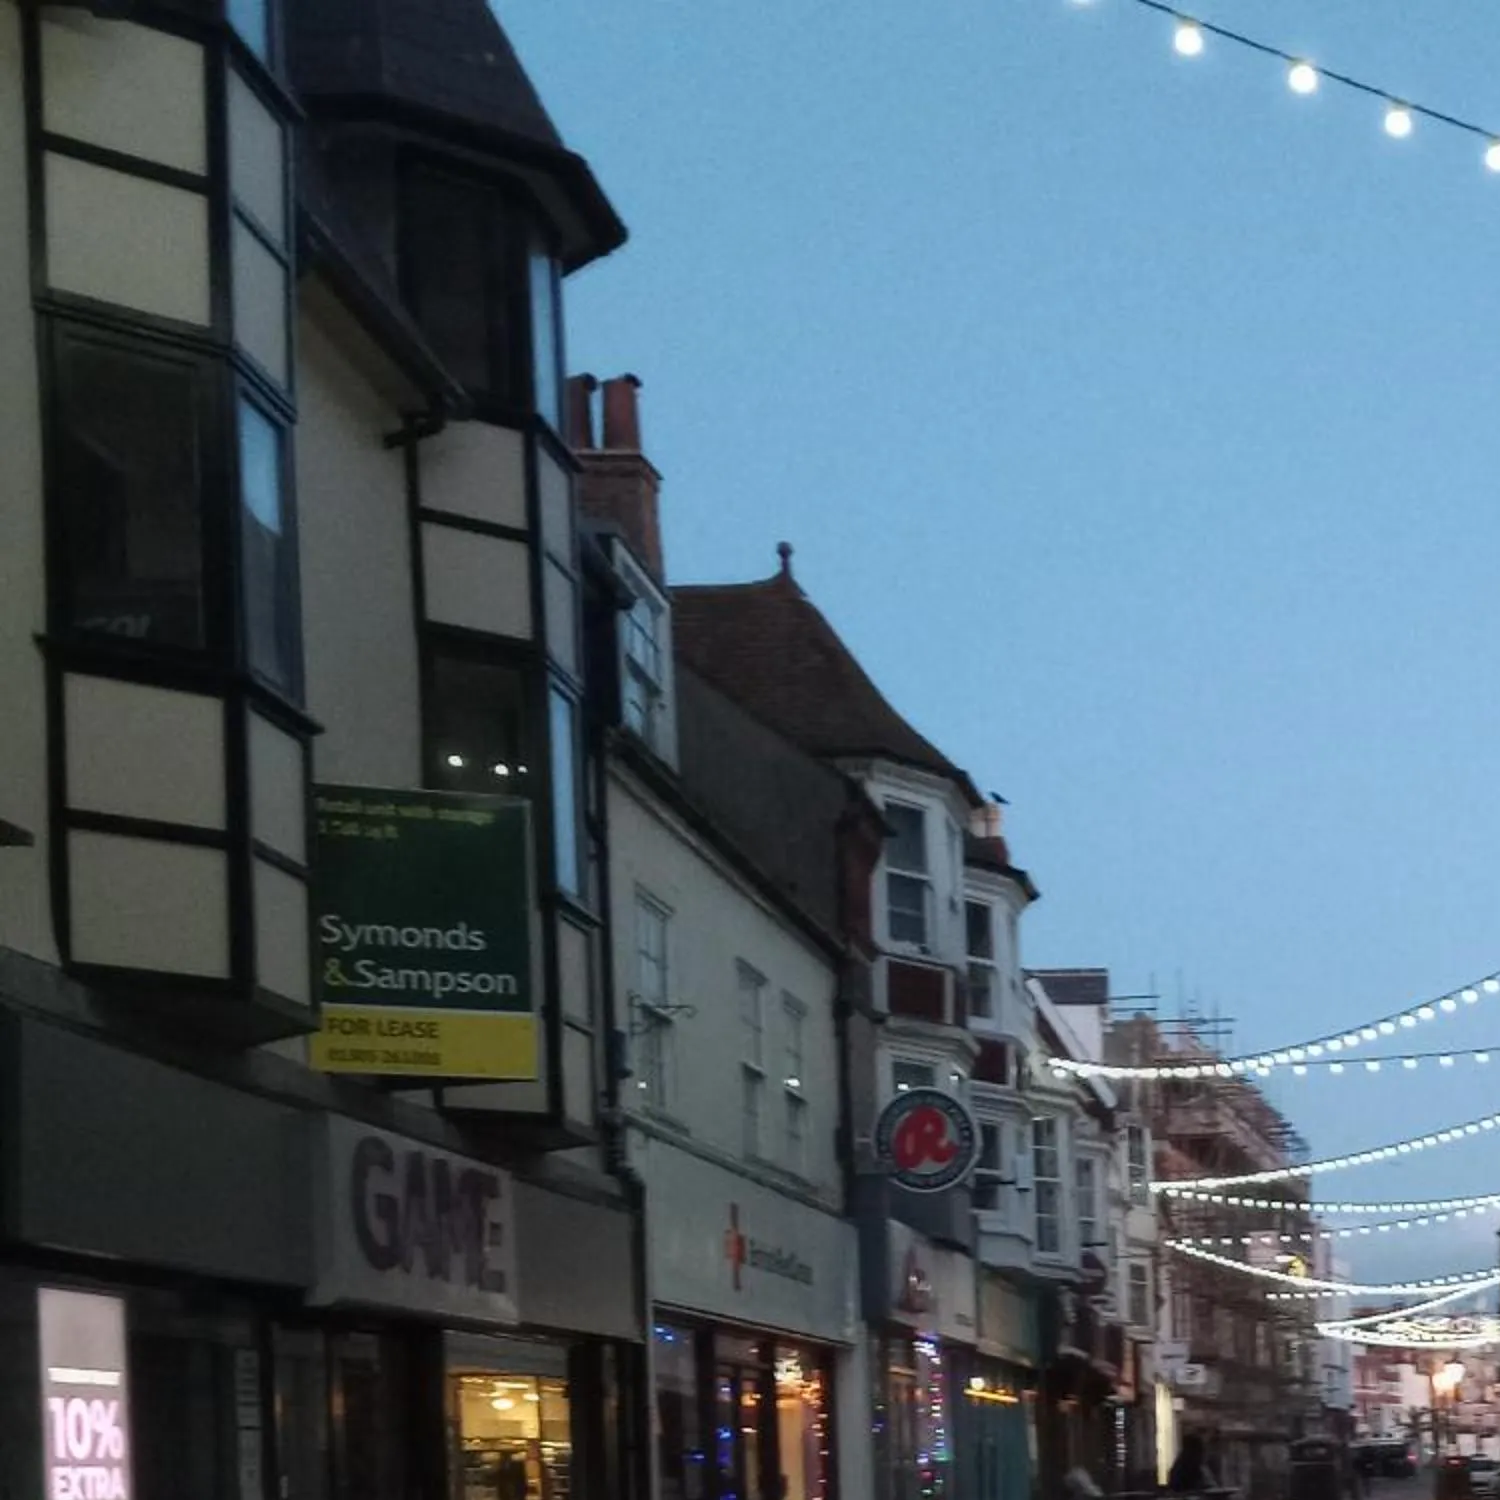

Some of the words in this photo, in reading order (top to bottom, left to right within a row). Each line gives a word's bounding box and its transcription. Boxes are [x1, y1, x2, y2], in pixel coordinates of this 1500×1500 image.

[320, 914, 487, 951] Symonds
[354, 959, 518, 998] Sampson
[327, 1016, 370, 1037] FOR
[376, 1020, 440, 1040] LEASE
[353, 1135, 505, 1292] GAME
[47, 1396, 125, 1461] 10%
